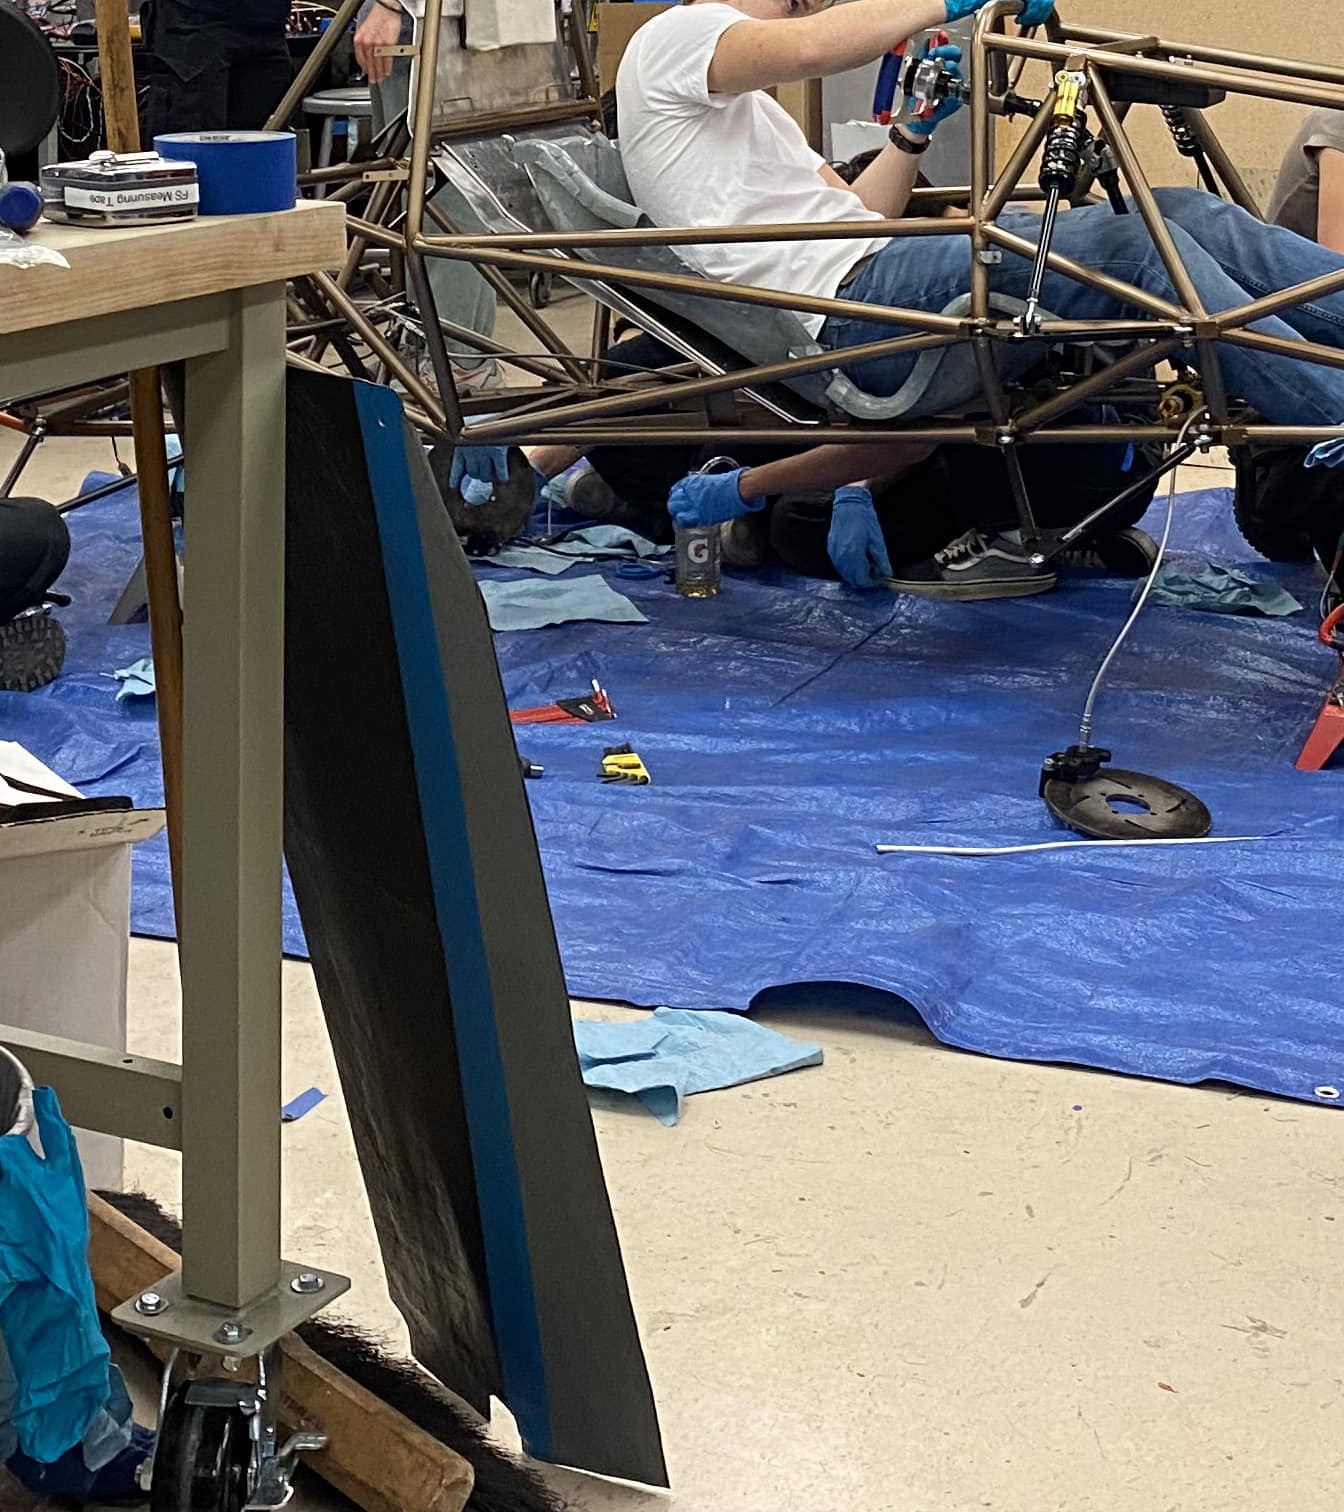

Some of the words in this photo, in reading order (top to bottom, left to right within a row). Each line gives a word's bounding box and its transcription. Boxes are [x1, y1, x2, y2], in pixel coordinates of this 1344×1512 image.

[89, 194, 114, 207] Tape
[117, 192, 173, 204] Measuring
[175, 190, 189, 201] FS
